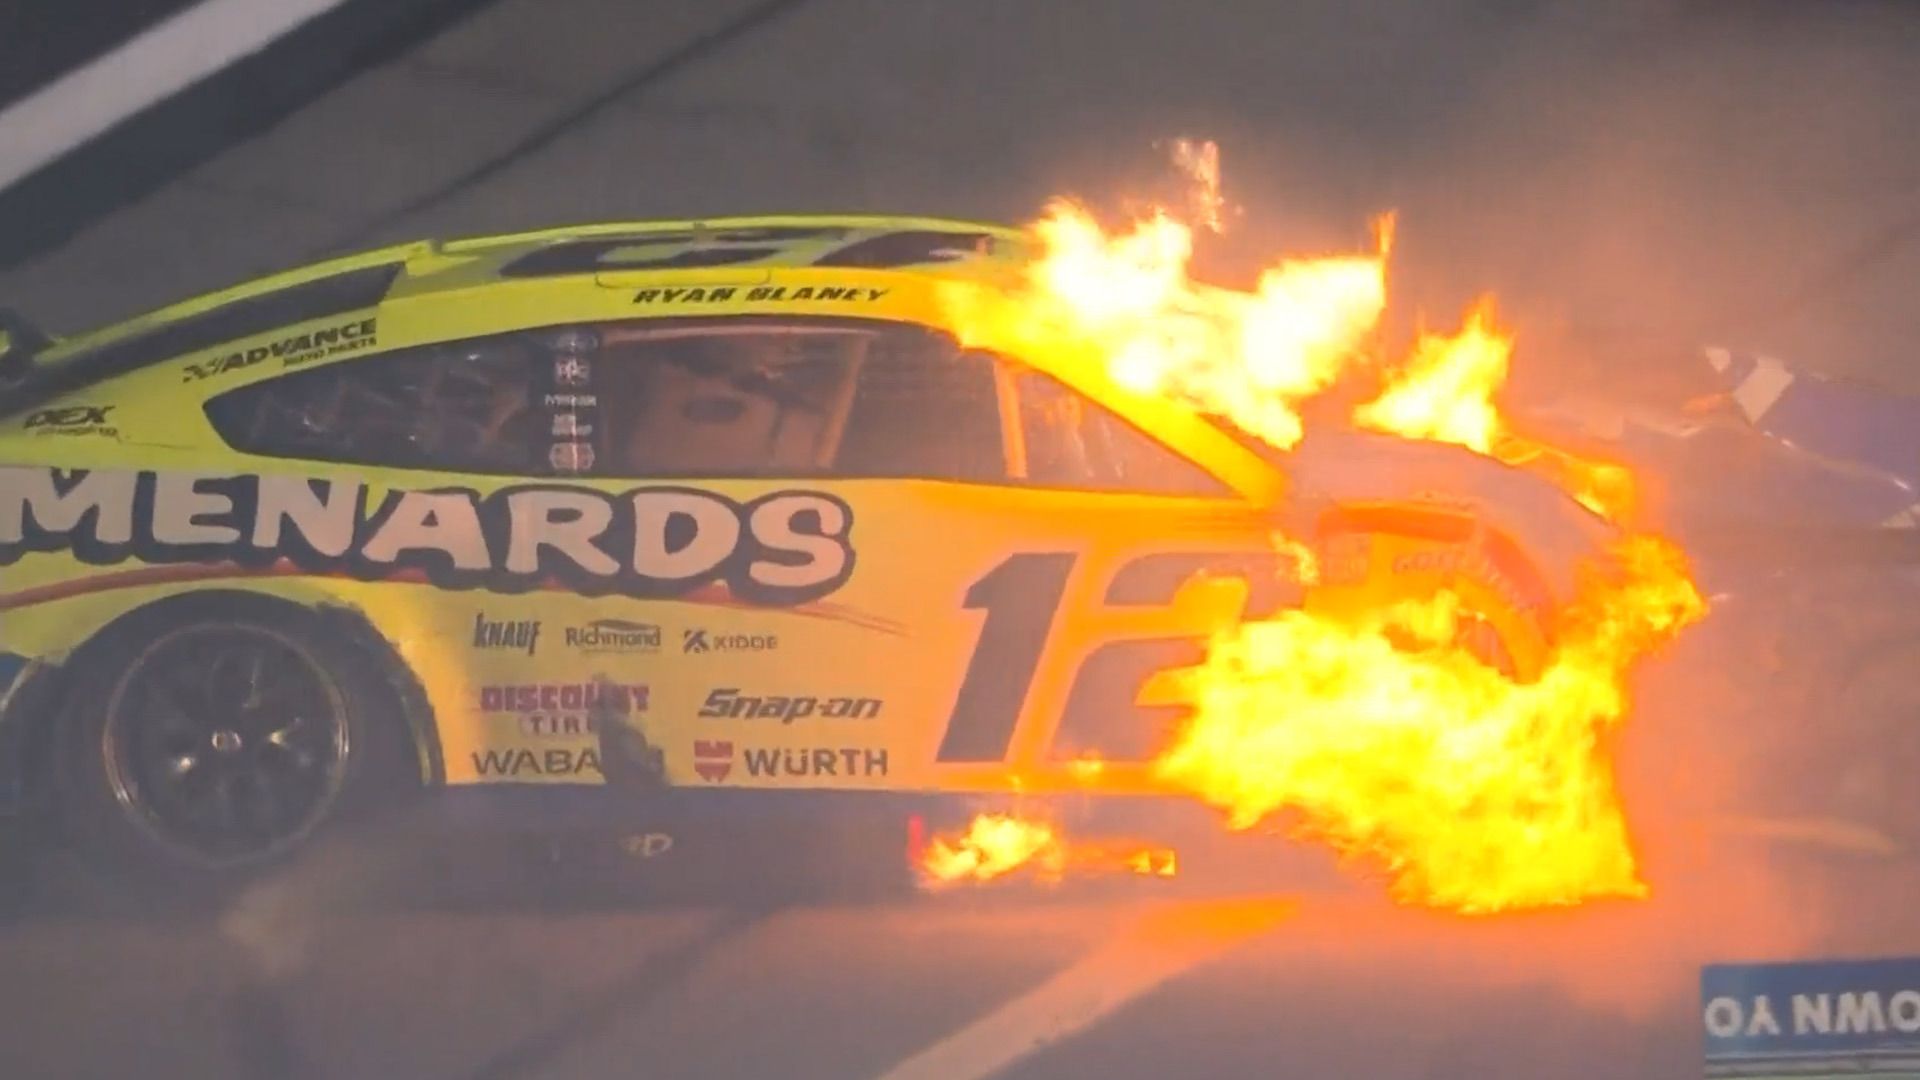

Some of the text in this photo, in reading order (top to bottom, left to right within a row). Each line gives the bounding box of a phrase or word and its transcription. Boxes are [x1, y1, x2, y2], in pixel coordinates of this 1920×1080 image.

[632, 286, 890, 305] RYAN BLANEY
[220, 318, 377, 374] ADVANCE
[0, 465, 854, 606] MENARDS
[565, 625, 662, 647] Richmond
[713, 635, 778, 650] KIDDE
[936, 551, 1307, 763] 12
[698, 688, 883, 724] Snap-on
